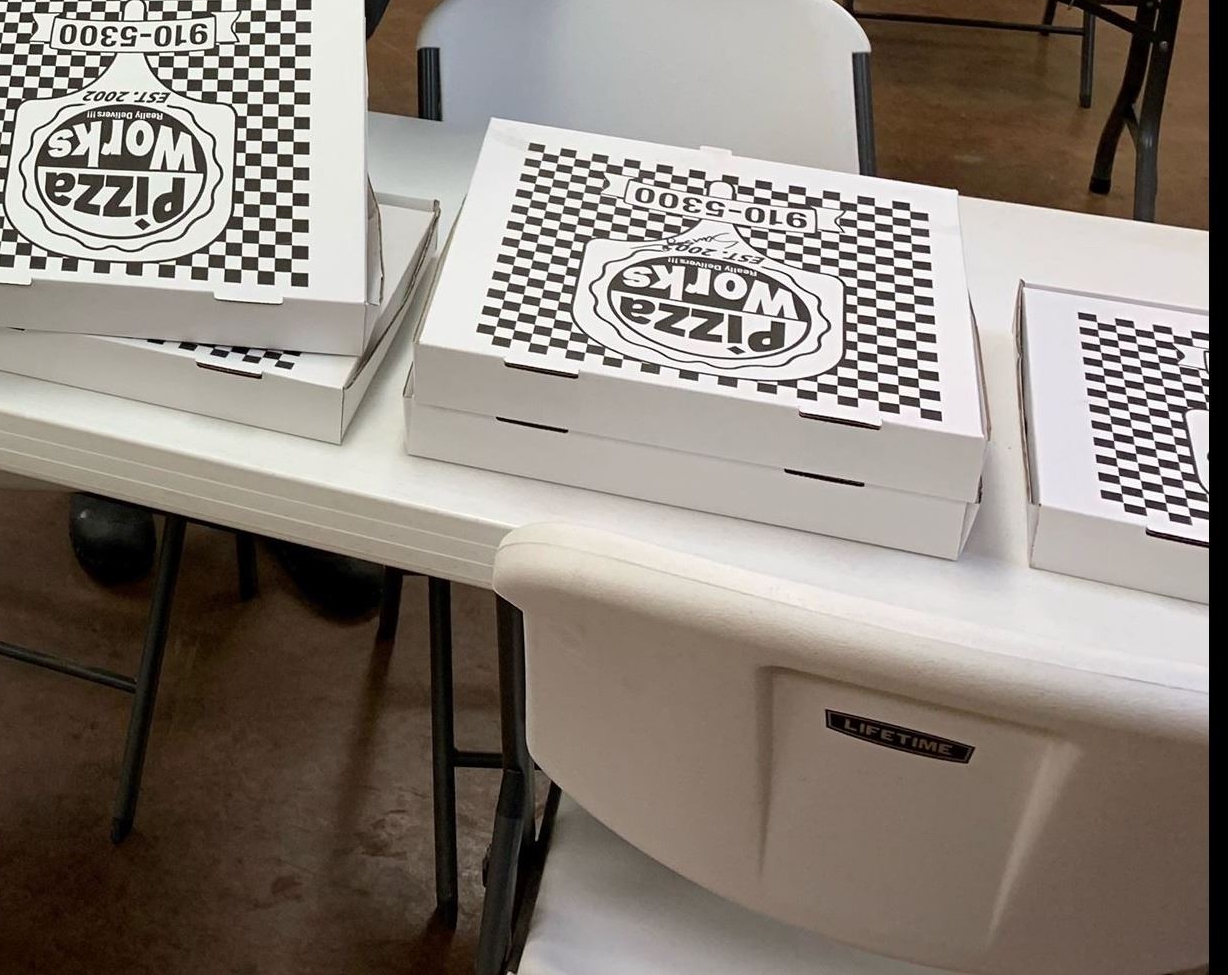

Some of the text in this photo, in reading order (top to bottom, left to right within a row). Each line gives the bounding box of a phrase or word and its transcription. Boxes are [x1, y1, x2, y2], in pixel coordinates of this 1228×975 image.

[59, 23, 208, 47] 910-5300
[82, 90, 172, 104] EST. 2002
[97, 110, 133, 119] Delivers
[134, 110, 164, 120] Really
[47, 119, 197, 172] Works
[45, 172, 186, 231] Pizza
[634, 187, 808, 228] 910-5300
[722, 250, 765, 265] EST.
[724, 263, 758, 277] Really
[622, 264, 799, 321] Works
[619, 296, 786, 355] Pizza
[843, 718, 953, 755] LIFETIME
